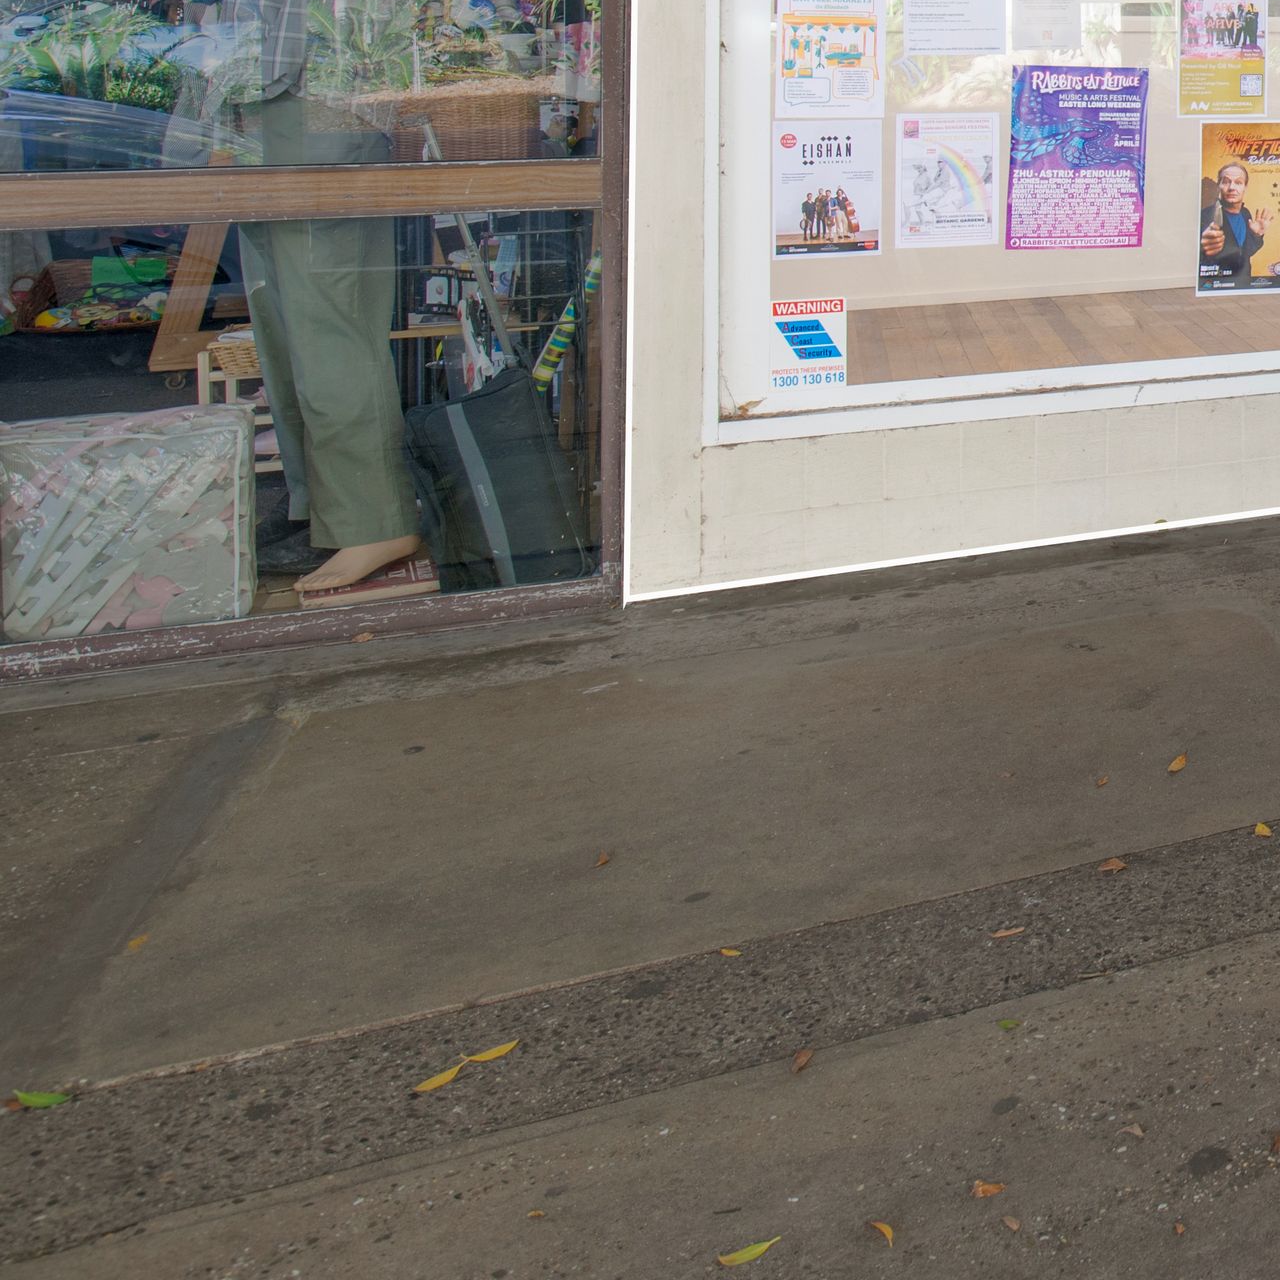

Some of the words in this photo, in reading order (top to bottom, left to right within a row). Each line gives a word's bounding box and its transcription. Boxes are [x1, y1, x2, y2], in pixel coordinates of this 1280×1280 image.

[1031, 71, 1082, 93] RABBITS
[1083, 73, 1101, 90] EAT
[1100, 71, 1140, 91] LETTUCE
[802, 143, 852, 159] EISHAN
[1013, 169, 1033, 177] ZHU
[1039, 169, 1075, 178] ASTRIX
[1080, 169, 1130, 178] PENDULUM
[1022, 238, 1127, 247] RABBITSEATLETTUCE.COM.AU
[775, 300, 842, 315] WARNING
[782, 322, 820, 333] Advanced
[791, 334, 813, 347] Coast
[799, 347, 833, 360] Security
[818, 364, 845, 372] PREMISES
[772, 375, 799, 387] 1300
[802, 373, 822, 385] 130
[825, 371, 845, 383] 618
